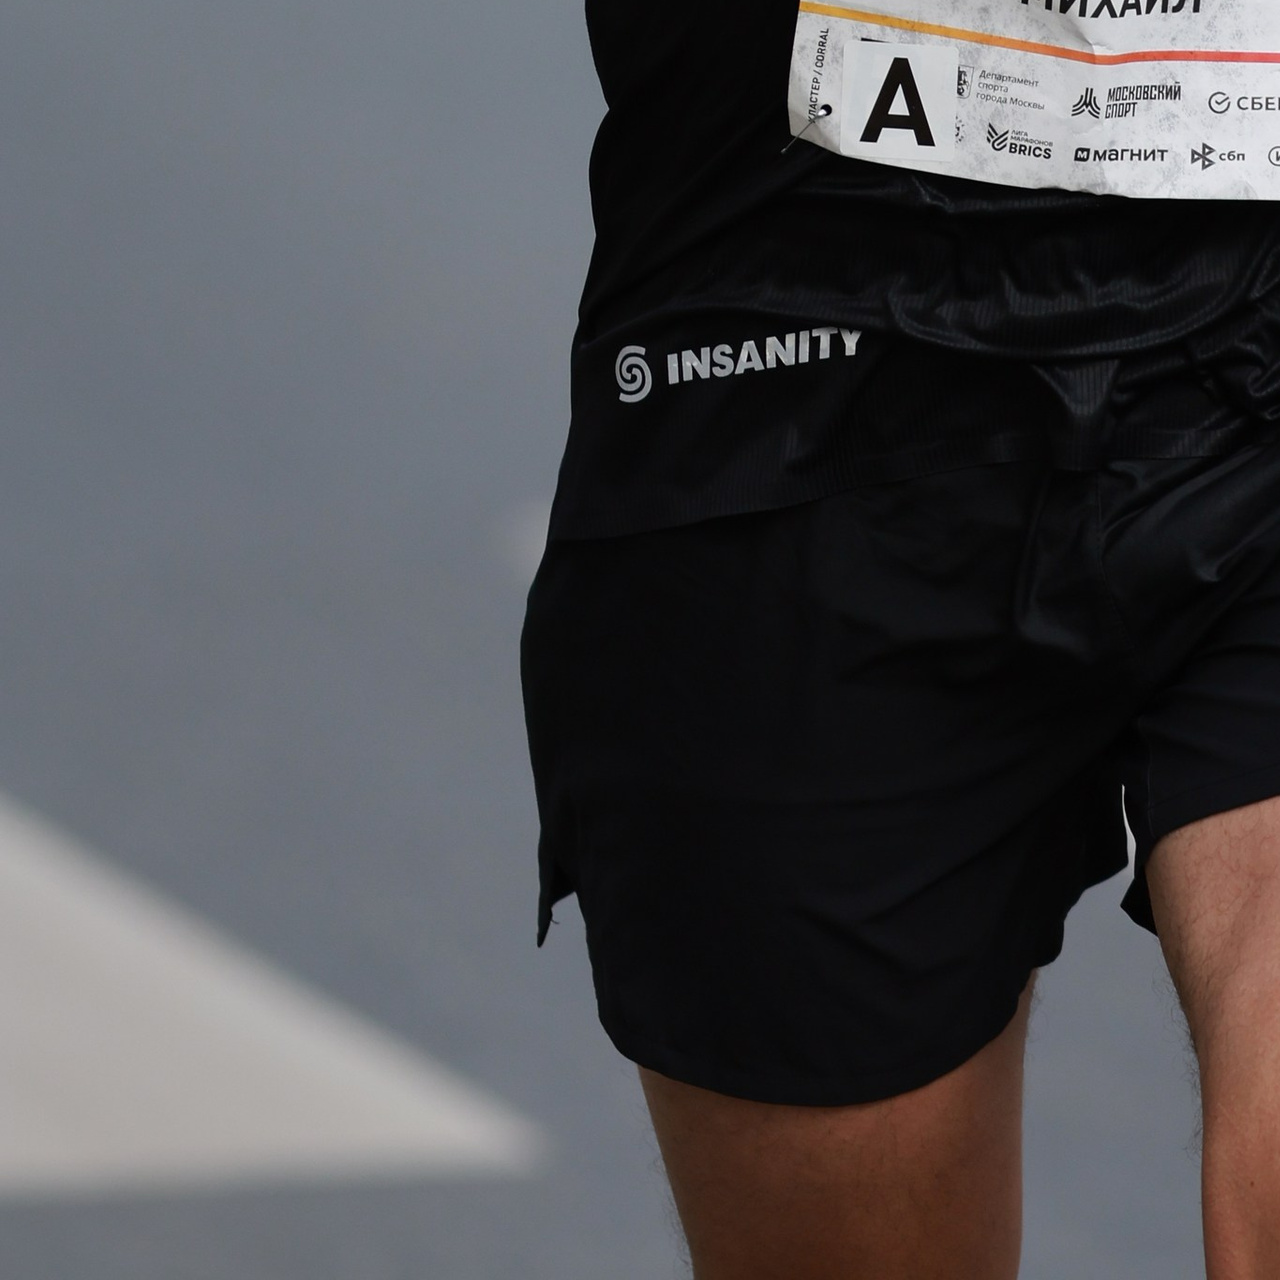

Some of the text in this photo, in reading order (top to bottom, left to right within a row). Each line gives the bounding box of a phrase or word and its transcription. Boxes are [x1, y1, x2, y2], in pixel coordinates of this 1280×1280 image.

[815, 28, 829, 68] CORRAL
[977, 81, 1009, 93] спорта
[979, 70, 1039, 87] Департамент
[976, 92, 1045, 110] города Москвы
[1107, 82, 1181, 102] МОСКОВСКИЙ
[859, 57, 936, 147] A
[1105, 101, 1138, 119] СПОРТ
[1009, 142, 1052, 159] BRICS
[1219, 149, 1245, 162] сбп
[667, 327, 862, 385] INSANITY
